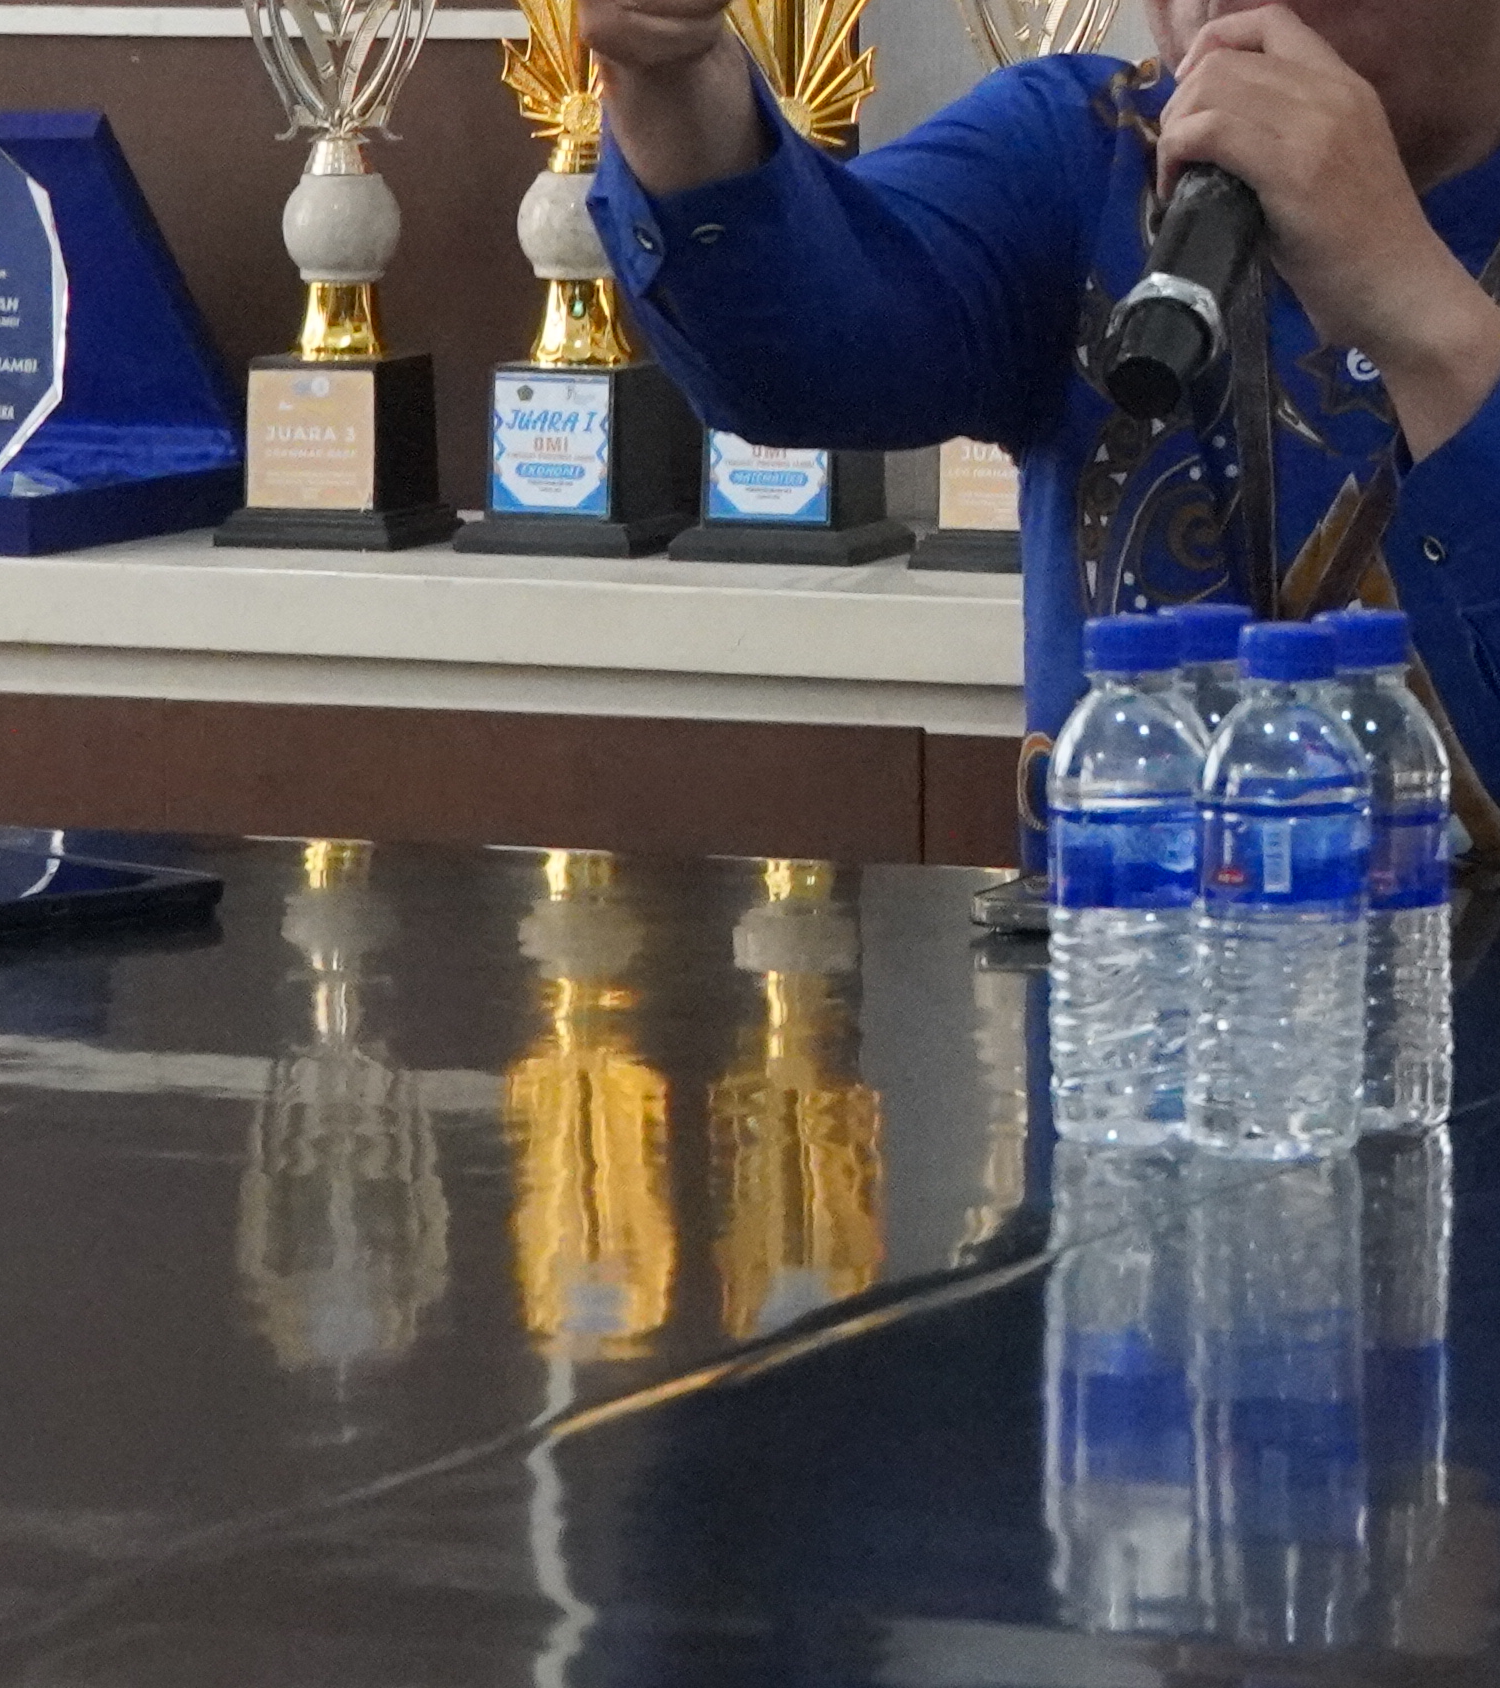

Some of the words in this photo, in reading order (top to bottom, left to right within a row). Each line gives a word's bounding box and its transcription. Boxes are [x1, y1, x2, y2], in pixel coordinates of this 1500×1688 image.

[506, 410, 580, 433] JUARA
[266, 425, 336, 441] JUARA
[346, 425, 356, 442] 3
